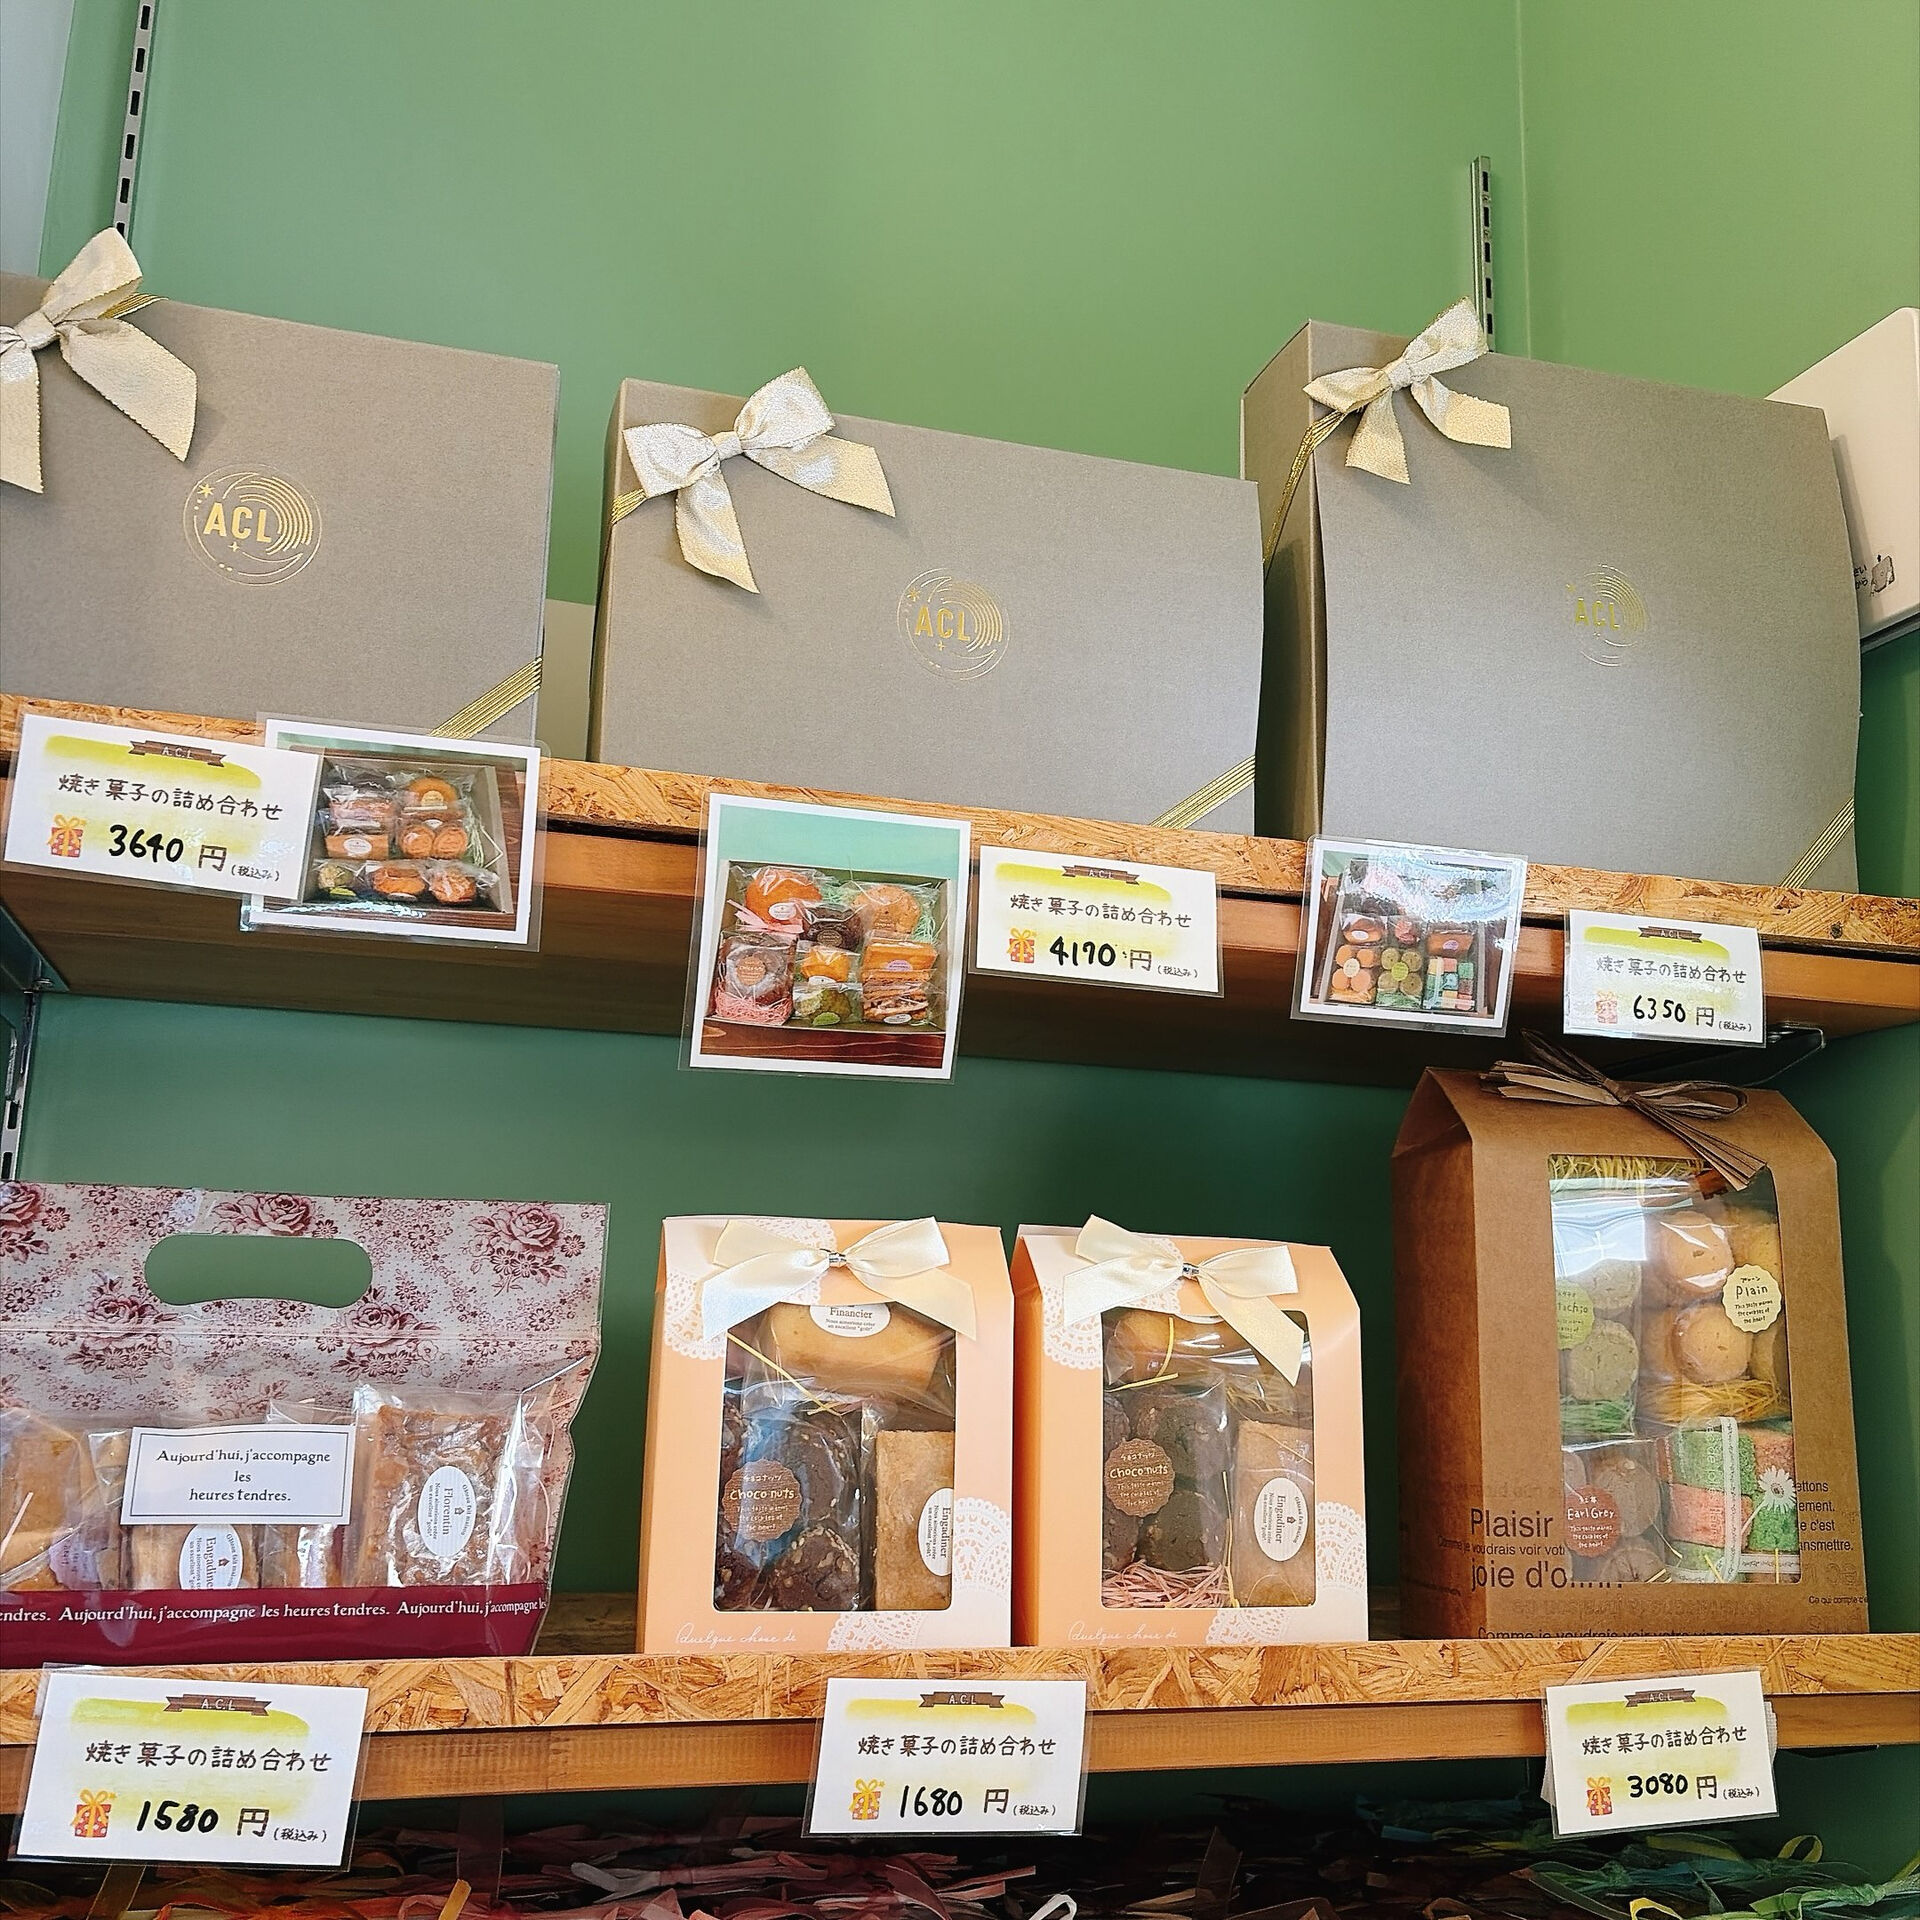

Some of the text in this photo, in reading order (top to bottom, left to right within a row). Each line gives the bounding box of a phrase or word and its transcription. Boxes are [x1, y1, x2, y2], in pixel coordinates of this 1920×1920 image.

[203, 502, 272, 543] ACL
[915, 605, 970, 641] ACL
[1575, 597, 1620, 630] ACL
[58, 773, 284, 821] 焼き菓子の詰め合わせ
[108, 824, 184, 863] 3640
[197, 844, 228, 872] 円
[1010, 893, 1191, 928] 焼き菓子の詰め合わせ
[1049, 936, 1116, 966] 4170
[1129, 949, 1152, 971] 円
[1596, 956, 1747, 984] 焼き菓子の詰め合わせ
[1633, 995, 1686, 1023] 6350
[1696, 1007, 1714, 1027] 円
[1736, 1286, 1768, 1299] Plain
[830, 1307, 872, 1318] Financier
[234, 1471, 251, 1482] les
[1146, 1465, 1168, 1475] nuts
[189, 1489, 291, 1501] heures tendres.
[771, 1488, 795, 1499] nuts
[442, 1488, 453, 1535] Florentin
[1275, 1495, 1286, 1544] Engadiner
[1471, 1508, 1553, 1537] Plaisir
[1568, 1508, 1614, 1520] Earl Grey
[1811, 1520, 1835, 1531] c'est
[940, 1507, 951, 1558] Engadiner
[1472, 1543, 1516, 1555] voudrais
[1520, 1545, 1541, 1555] voir
[1471, 1558, 1515, 1592] joie
[260, 1605, 280, 1618] les
[283, 1604, 330, 1618] heures
[333, 1602, 390, 1616] tendres.
[84, 1740, 332, 1773] 焼き菓子の詰め合わせ
[858, 1734, 1057, 1757] 焼き菓子の詰め合わせ
[1582, 1726, 1747, 1756] 焼き菓子の詰め合わせ
[1627, 1772, 1688, 1798] 3080
[1696, 1775, 1717, 1799] 円
[900, 1785, 963, 1818] 1680
[983, 1788, 1009, 1814] 円
[136, 1800, 219, 1834] 1580
[236, 1807, 270, 1838] 円
